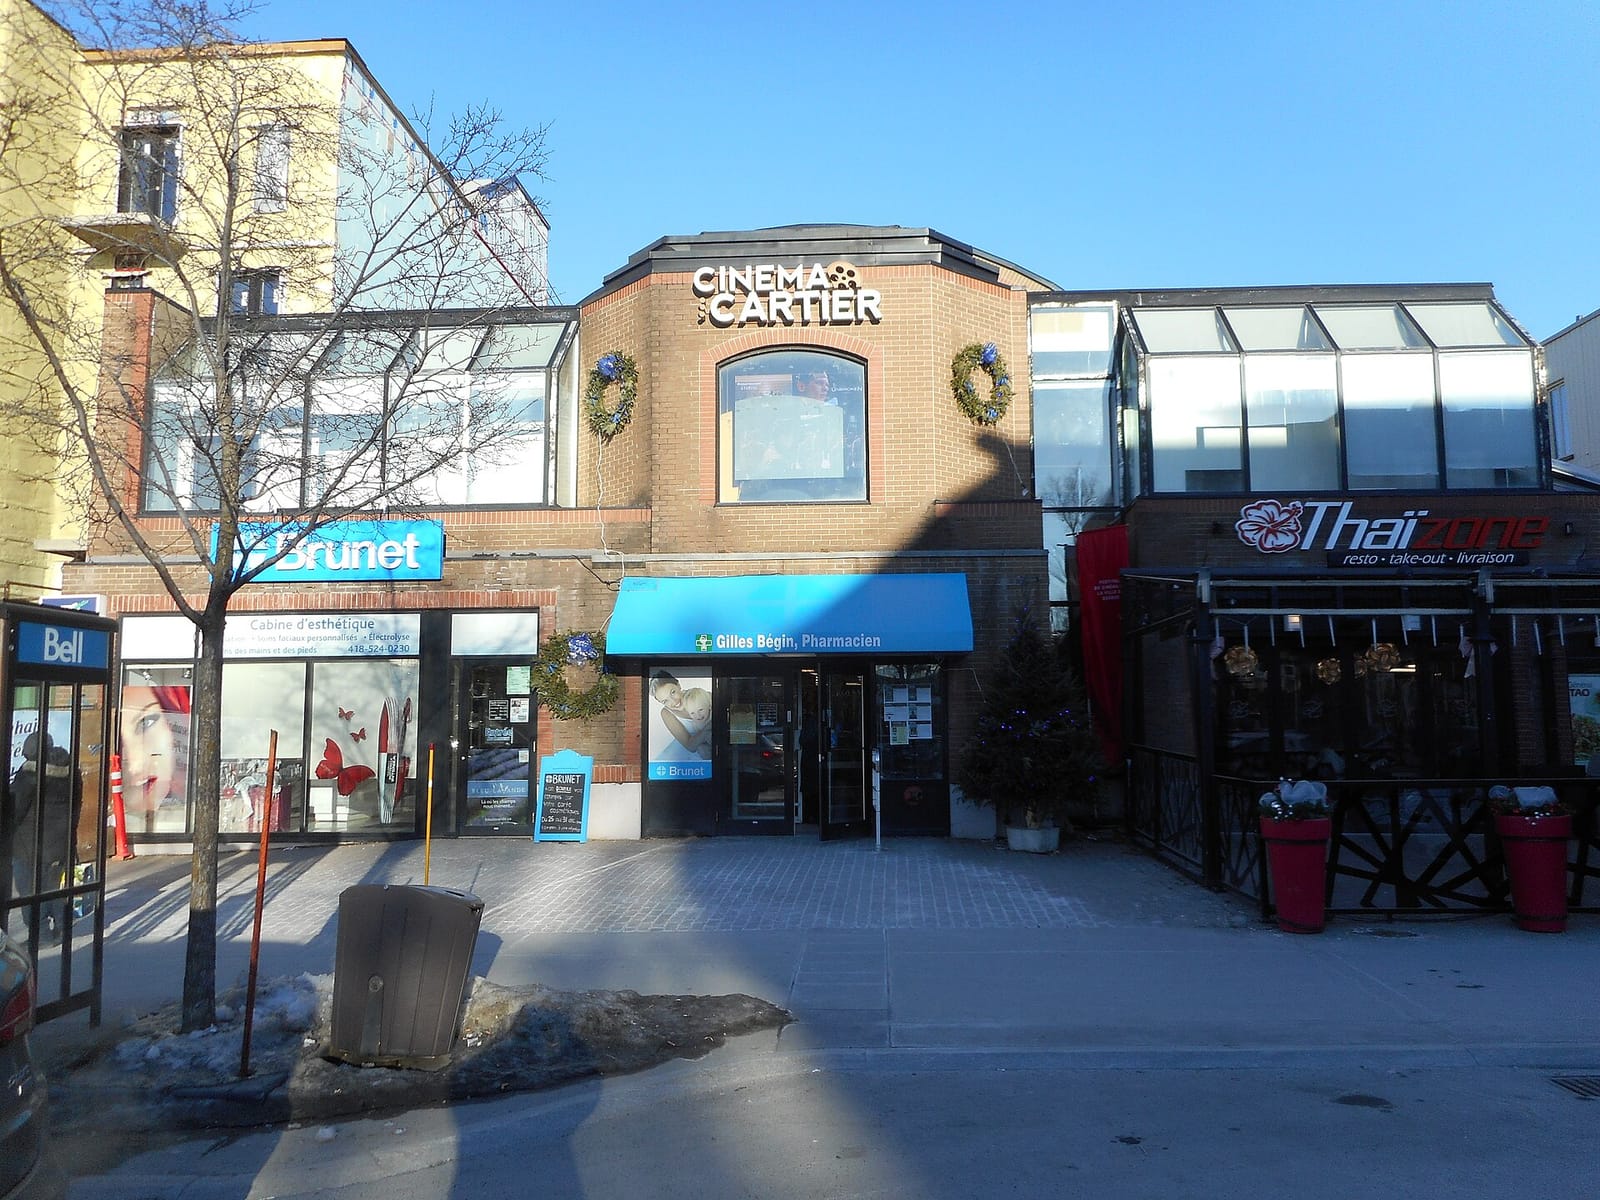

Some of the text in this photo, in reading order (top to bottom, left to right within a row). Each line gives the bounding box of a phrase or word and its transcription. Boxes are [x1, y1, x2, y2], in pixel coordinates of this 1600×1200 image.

[692, 263, 830, 296] CINEMA
[709, 289, 882, 327] CARTIER
[275, 533, 420, 570] Brunet
[1343, 553, 1514, 564] resto take-out livraison
[250, 618, 375, 632] Cabine d'esthétique
[278, 634, 305, 642] faciaux
[307, 633, 358, 643] personnalisés
[369, 632, 410, 643] Électrolyse
[716, 633, 881, 650] Gilles Bégin, Pharmacien
[44, 628, 83, 663] Bell
[249, 646, 271, 654] mains
[282, 646, 296, 654] des
[297, 645, 317, 655] pieds
[348, 645, 410, 653] 418-524-0230
[1569, 689, 1590, 697] TAO
[669, 766, 705, 776] Brunet
[552, 774, 581, 784] BRUNET
